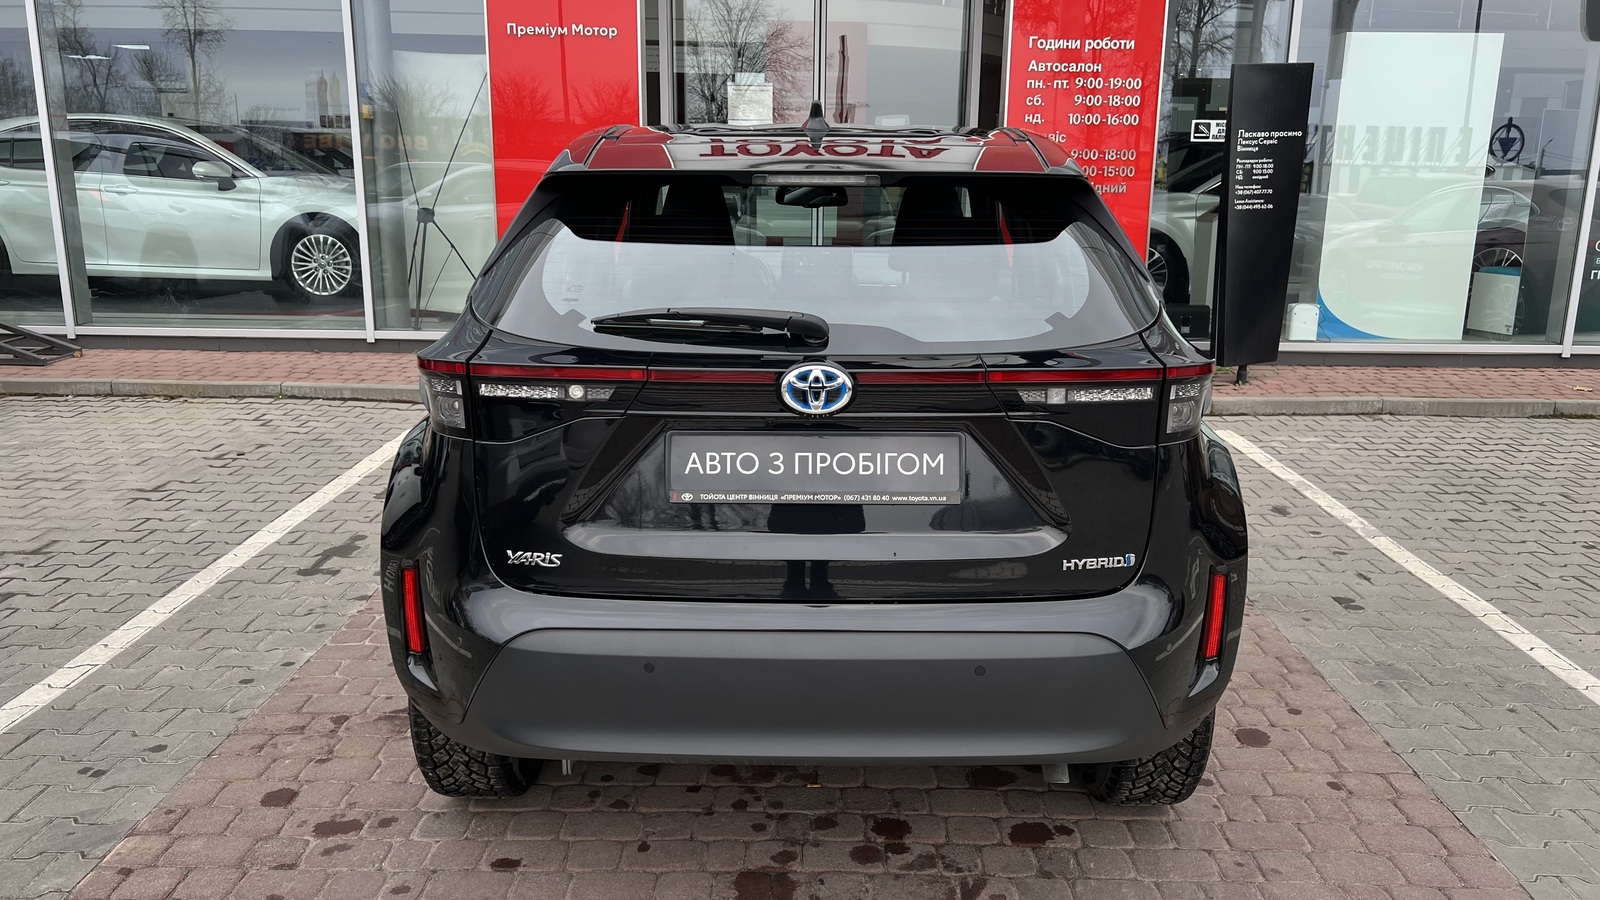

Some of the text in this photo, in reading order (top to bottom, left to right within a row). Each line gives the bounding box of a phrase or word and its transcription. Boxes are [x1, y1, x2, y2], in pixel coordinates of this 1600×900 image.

[506, 22, 618, 39] Преміум Мотор
[1028, 36, 1135, 52] Години роботи
[1028, 60, 1102, 73] Автосалон
[1075, 77, 1142, 90] 9:00-19:00
[1026, 94, 1141, 107] сб. 9:00-18:00
[1024, 113, 1139, 126] нд. 10:00-16:00
[1238, 129, 1303, 138] Ласкаво просимо
[1081, 165, 1135, 177] 00-15:00
[684, 452, 944, 476] АВТО З ПРОБІГОМ
[700, 492, 726, 501] ТОЙОТА
[726, 493, 748, 501] ЦЕНТР
[748, 493, 778, 501] ВІННИЦЯ
[843, 494, 860, 502] (067)
[1062, 556, 1125, 571] HYBRID
